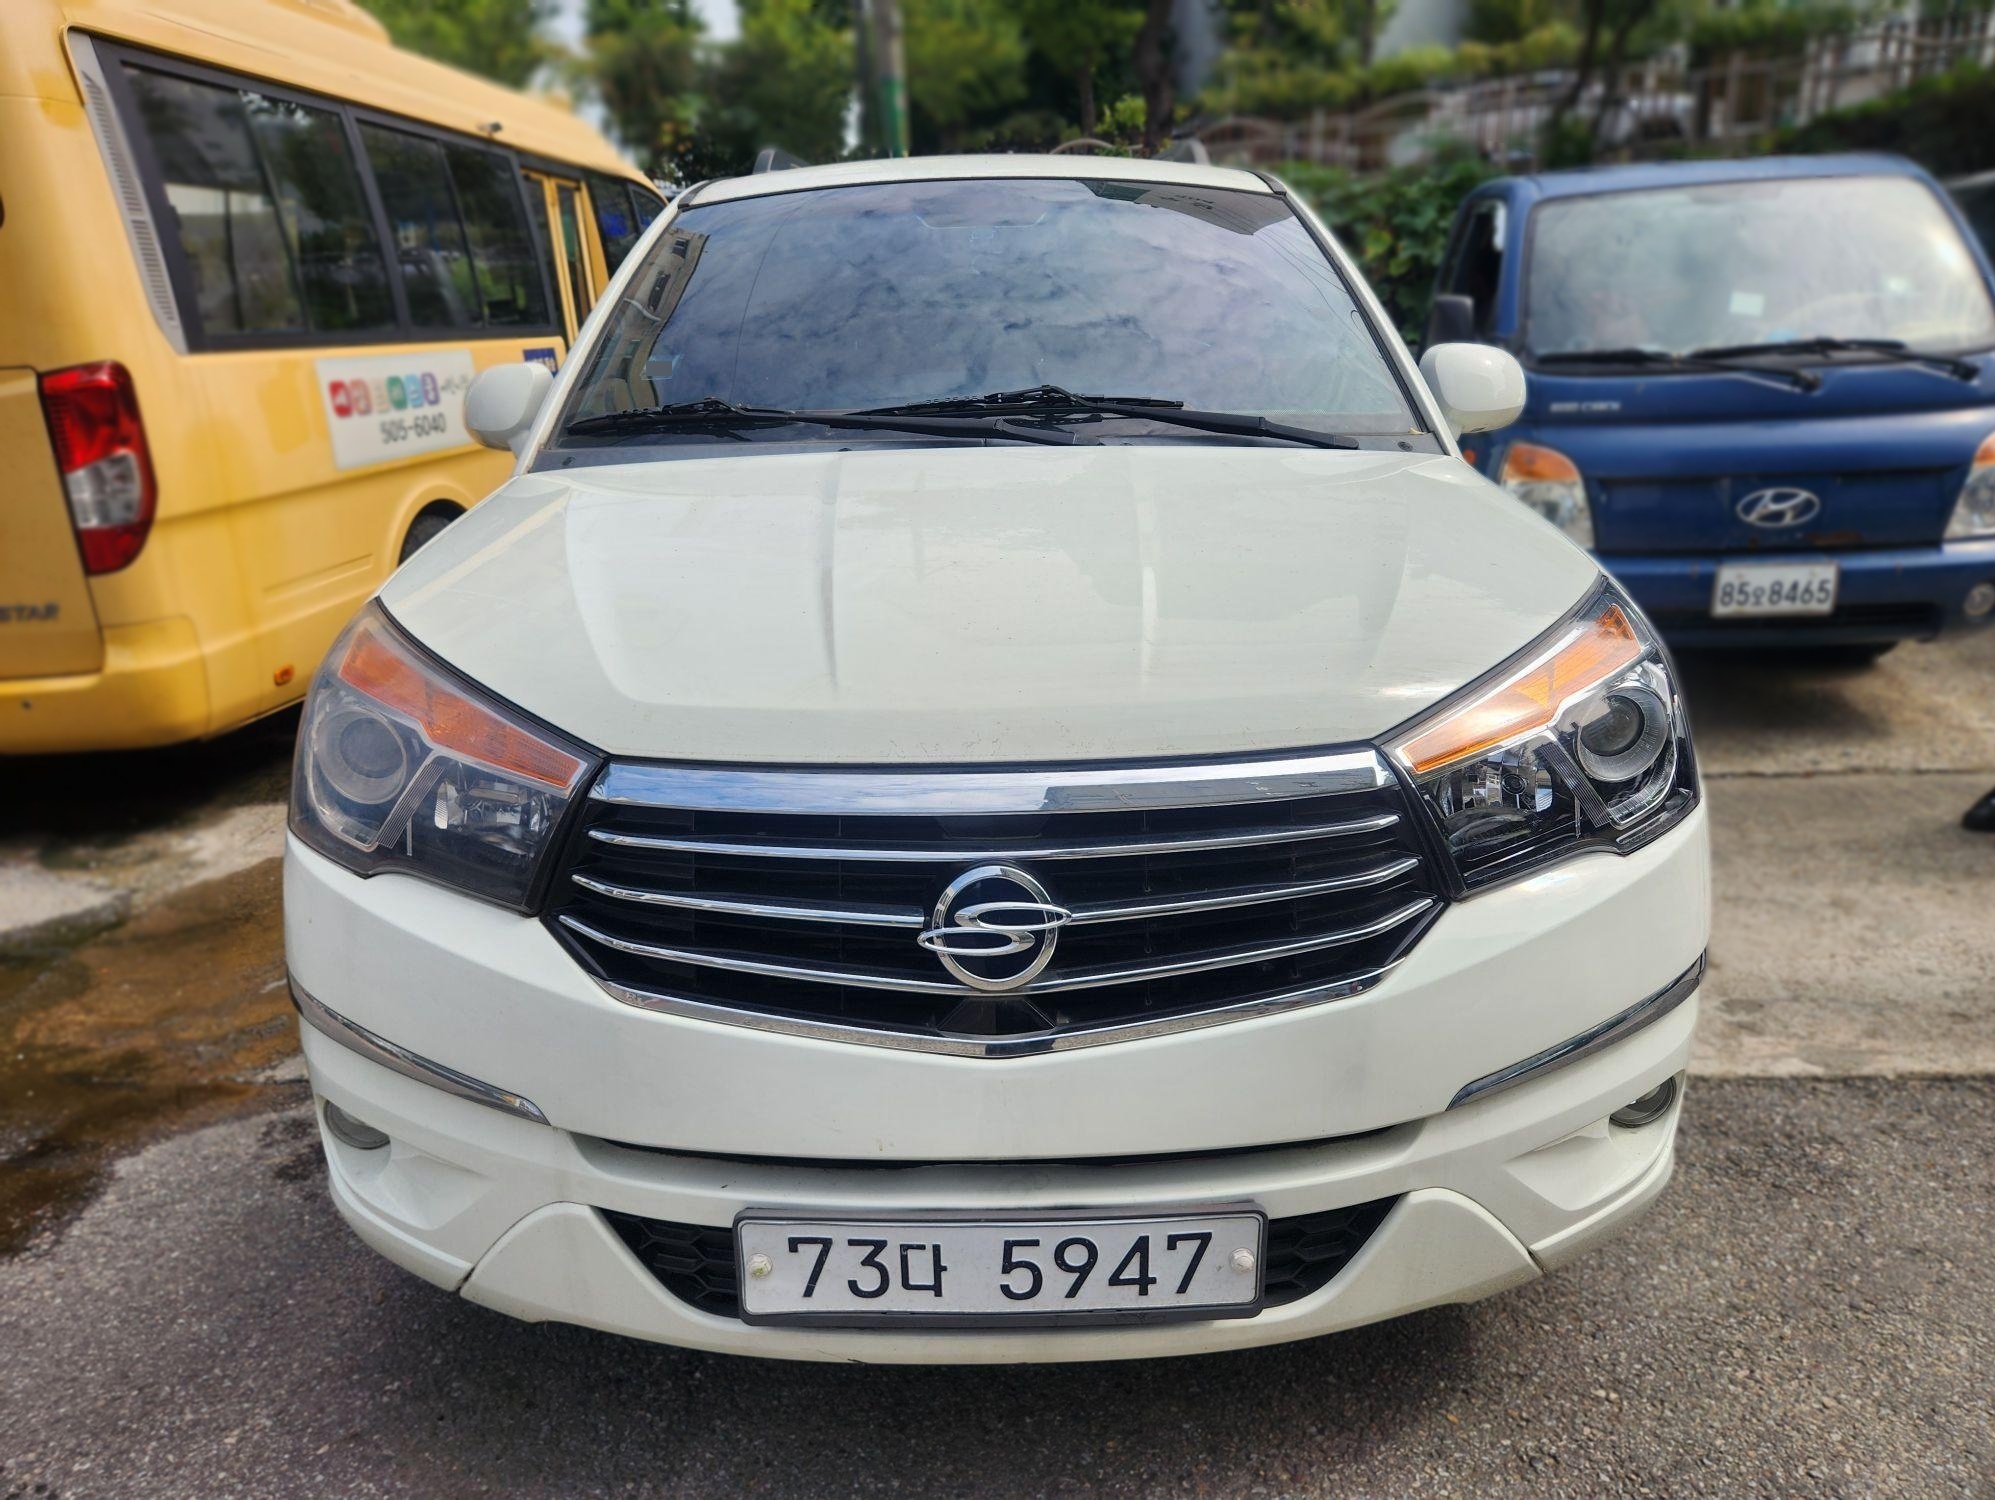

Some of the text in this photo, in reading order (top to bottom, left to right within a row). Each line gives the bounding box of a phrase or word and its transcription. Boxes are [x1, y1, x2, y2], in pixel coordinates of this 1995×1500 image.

[380, 412, 446, 444] 505-6040
[787, 1231, 1213, 1300] 73다 5947
